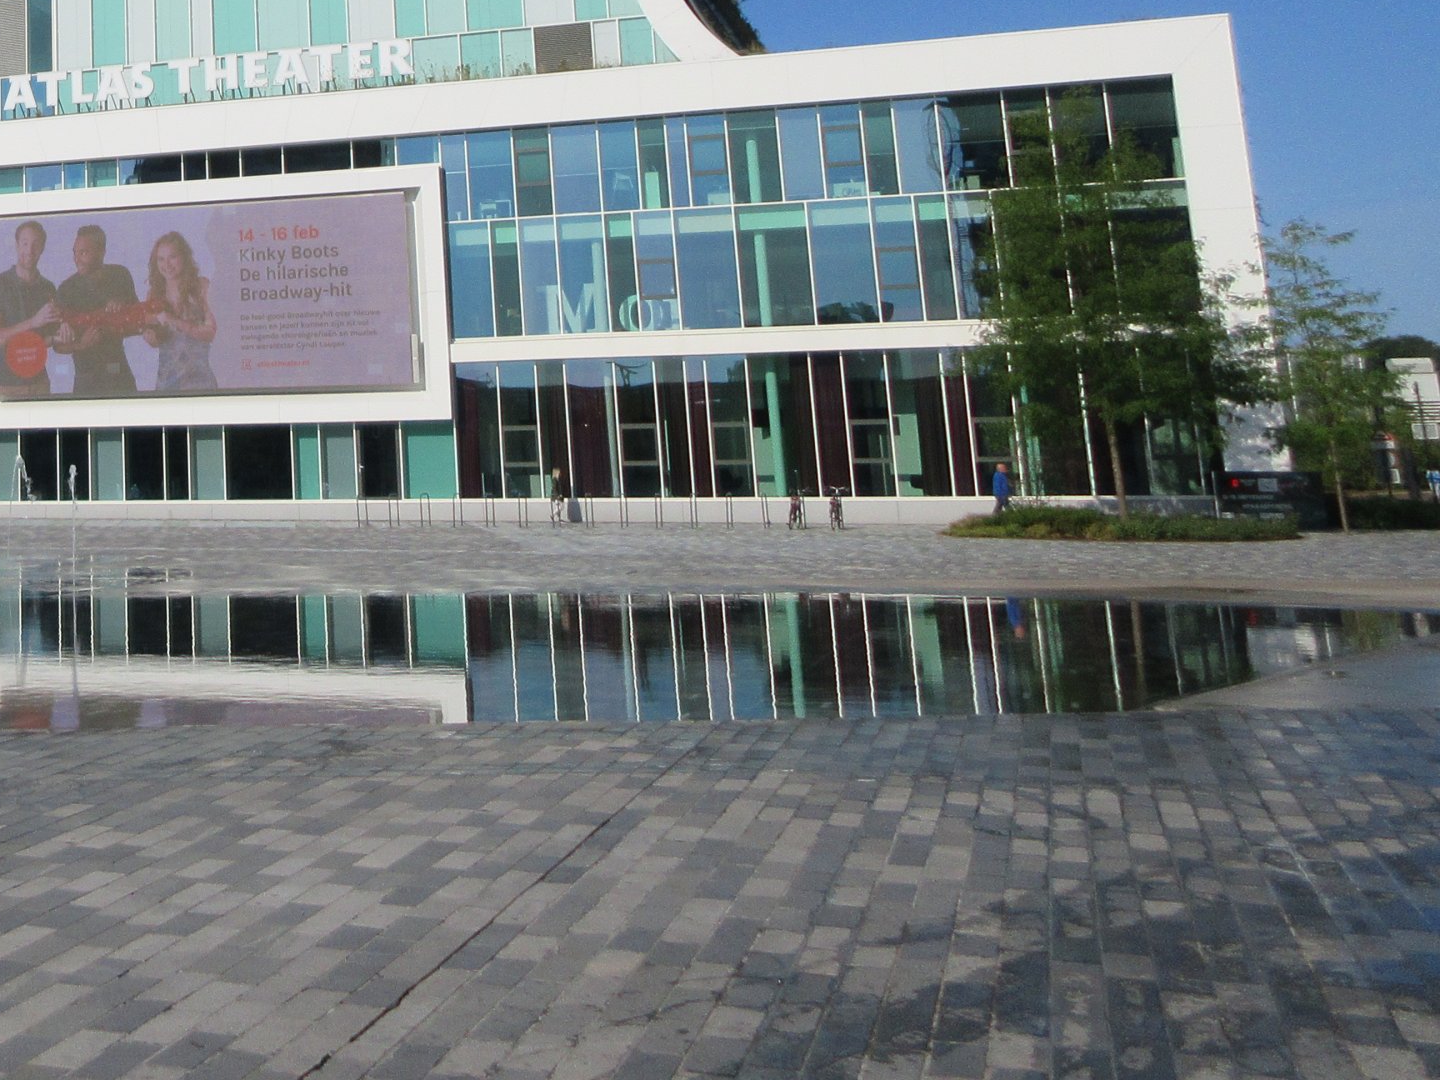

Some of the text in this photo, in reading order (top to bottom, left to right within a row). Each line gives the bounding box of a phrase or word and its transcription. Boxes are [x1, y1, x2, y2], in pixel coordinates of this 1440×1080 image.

[3, 38, 415, 112] ATLAS THEATER
[239, 228, 254, 242] 14
[271, 226, 288, 241] 16
[293, 225, 320, 240] feb
[239, 245, 339, 265] Kinky Boots
[240, 263, 349, 282] De hilarische
[240, 282, 353, 302] Broadway-hit
